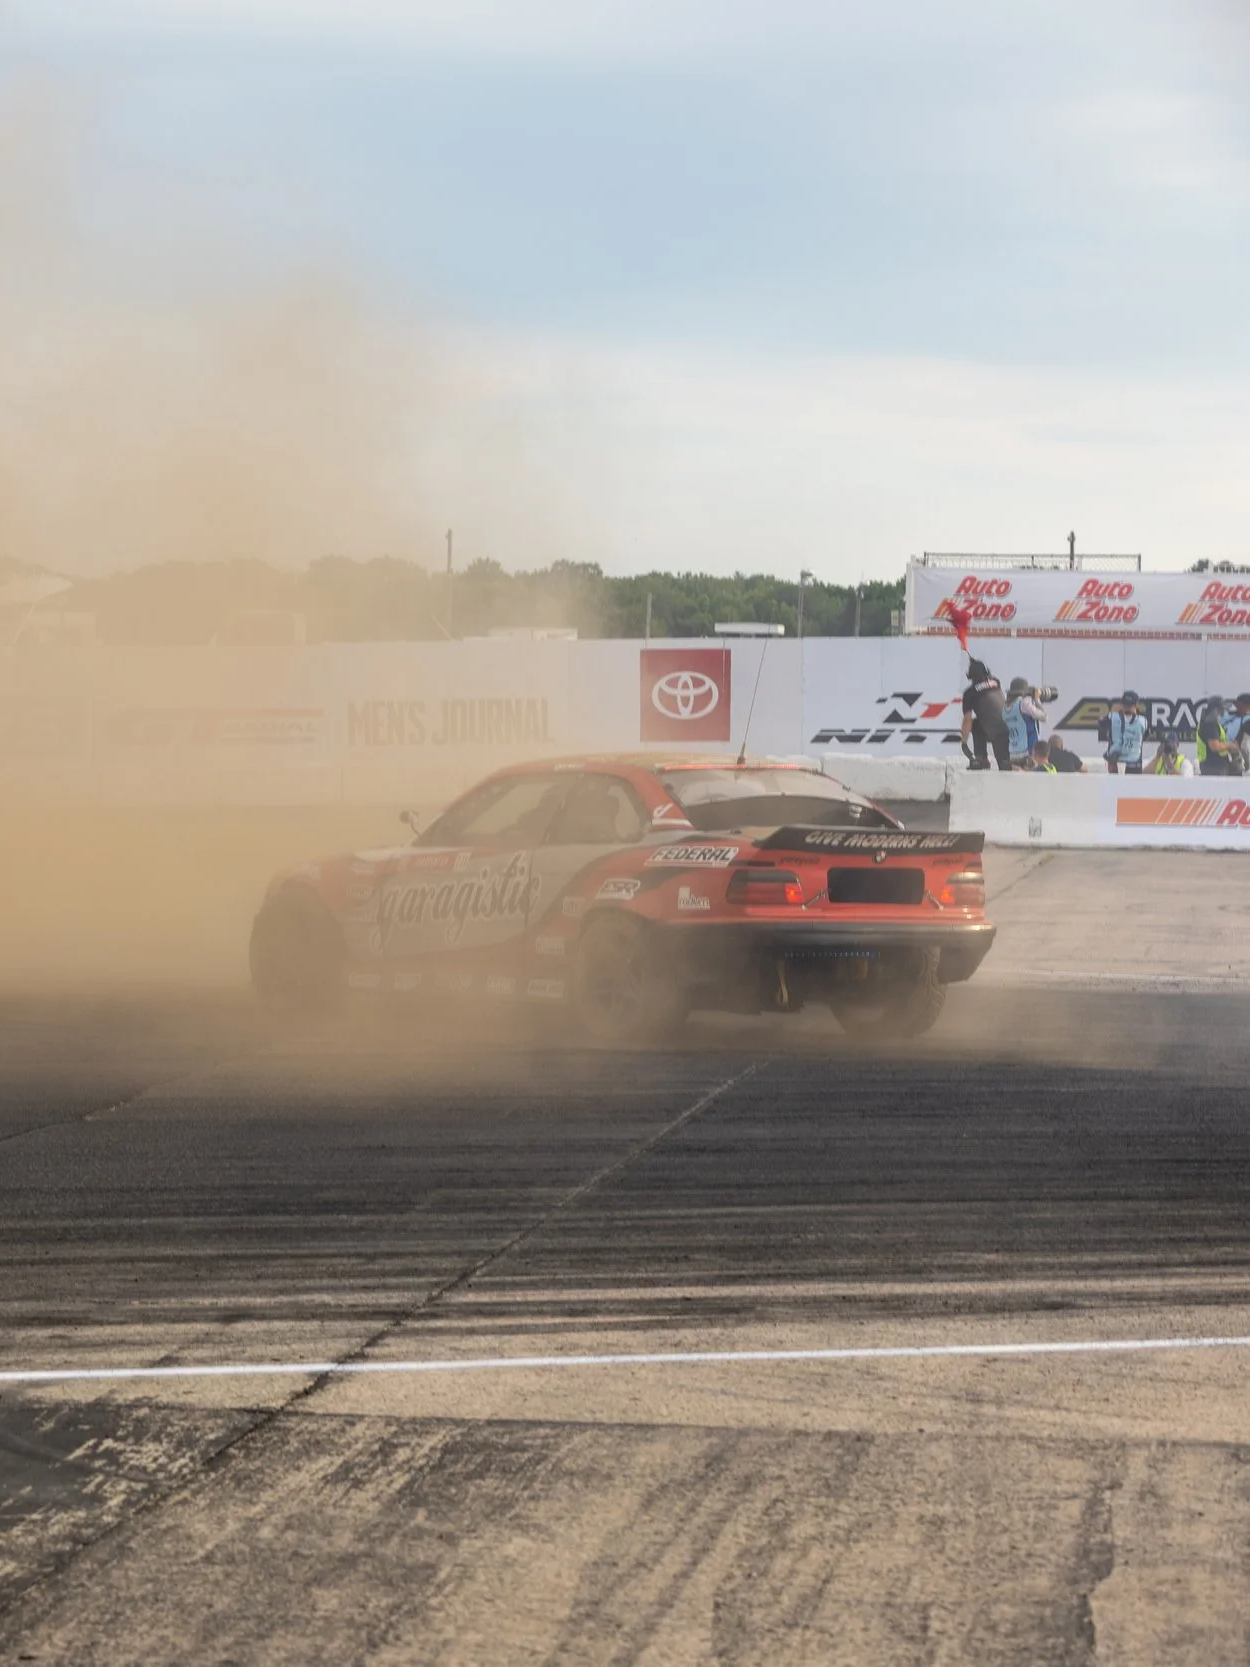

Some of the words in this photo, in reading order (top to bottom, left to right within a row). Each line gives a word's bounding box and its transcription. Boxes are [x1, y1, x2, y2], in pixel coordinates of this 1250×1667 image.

[955, 575, 1012, 596] Auto
[1077, 579, 1133, 599] Auto
[1078, 602, 1138, 623] Zone
[1199, 604, 1250, 625] Zon
[432, 697, 556, 745] JOURNAL
[652, 846, 732, 862] FEDERAL
